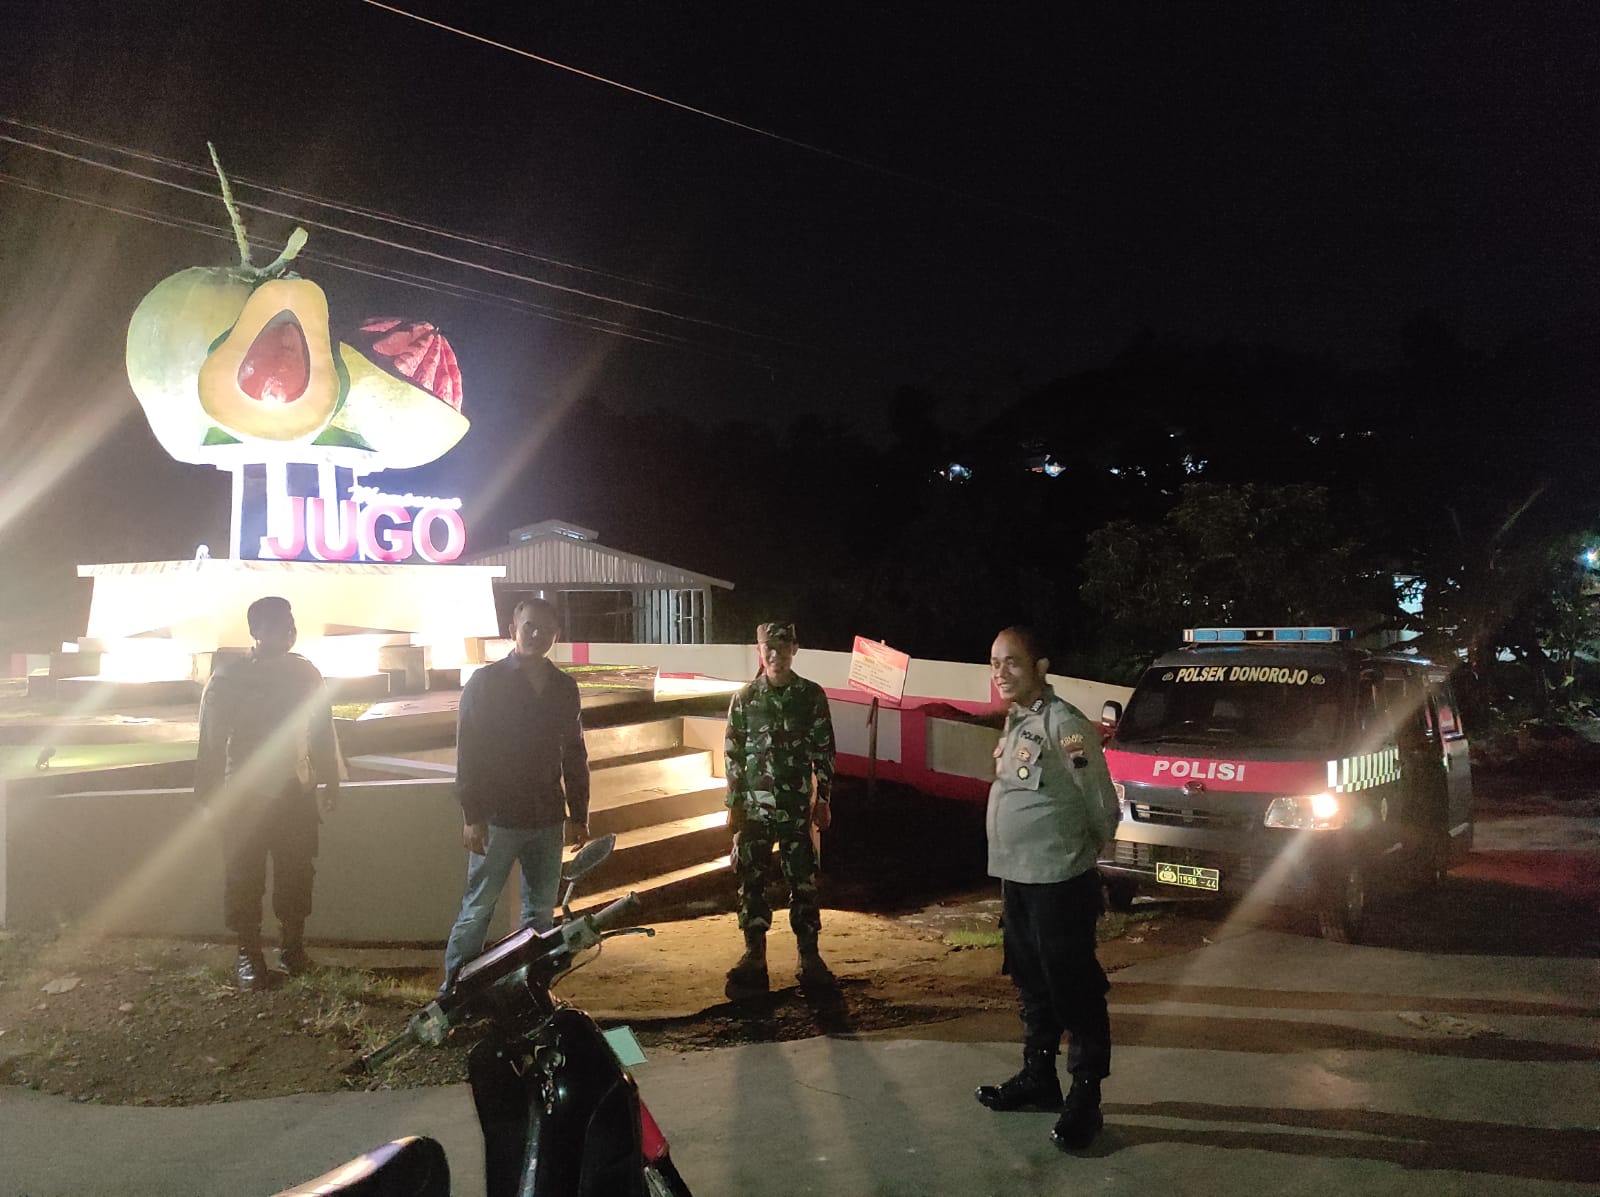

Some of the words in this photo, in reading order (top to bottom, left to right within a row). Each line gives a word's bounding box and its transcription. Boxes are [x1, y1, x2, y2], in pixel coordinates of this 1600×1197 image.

[258, 496, 466, 563] JUGO
[1176, 667, 1228, 683] POLSEK
[1229, 666, 1308, 685] DONOROJO
[1152, 760, 1245, 782] POLISI
